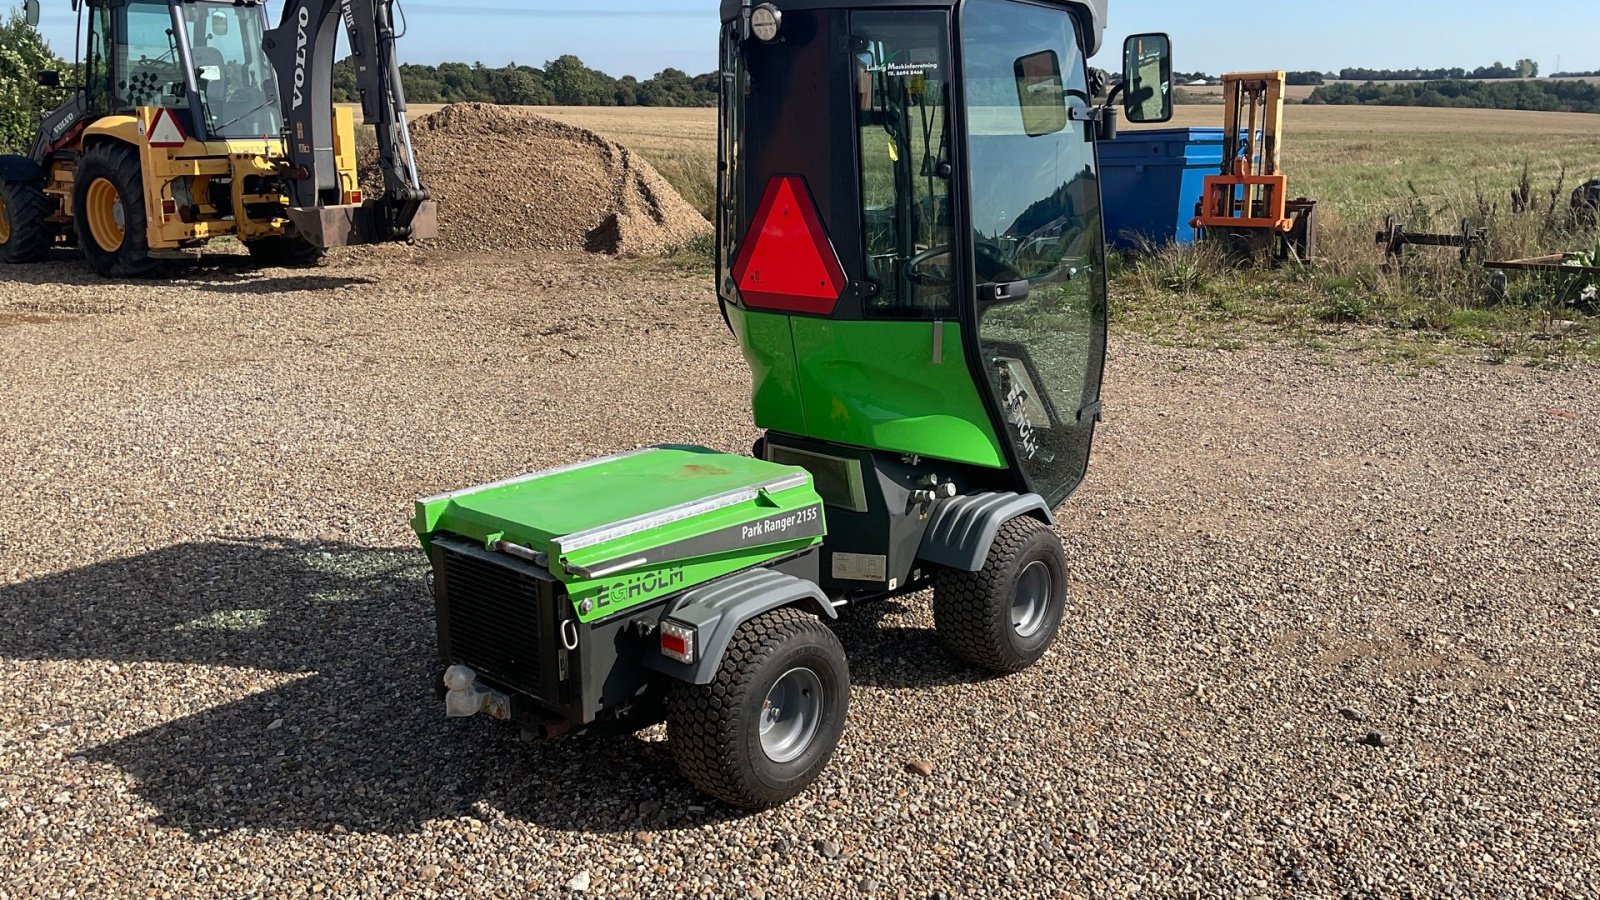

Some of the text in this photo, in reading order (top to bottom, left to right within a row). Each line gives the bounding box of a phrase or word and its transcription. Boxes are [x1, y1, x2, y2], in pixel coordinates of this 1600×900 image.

[342, 4, 355, 28] PLUS
[292, 6, 308, 111] VOLVO
[53, 112, 74, 134] VOLVO
[742, 507, 817, 540] Park Ranger 2155
[596, 564, 684, 608] EGHOLM
